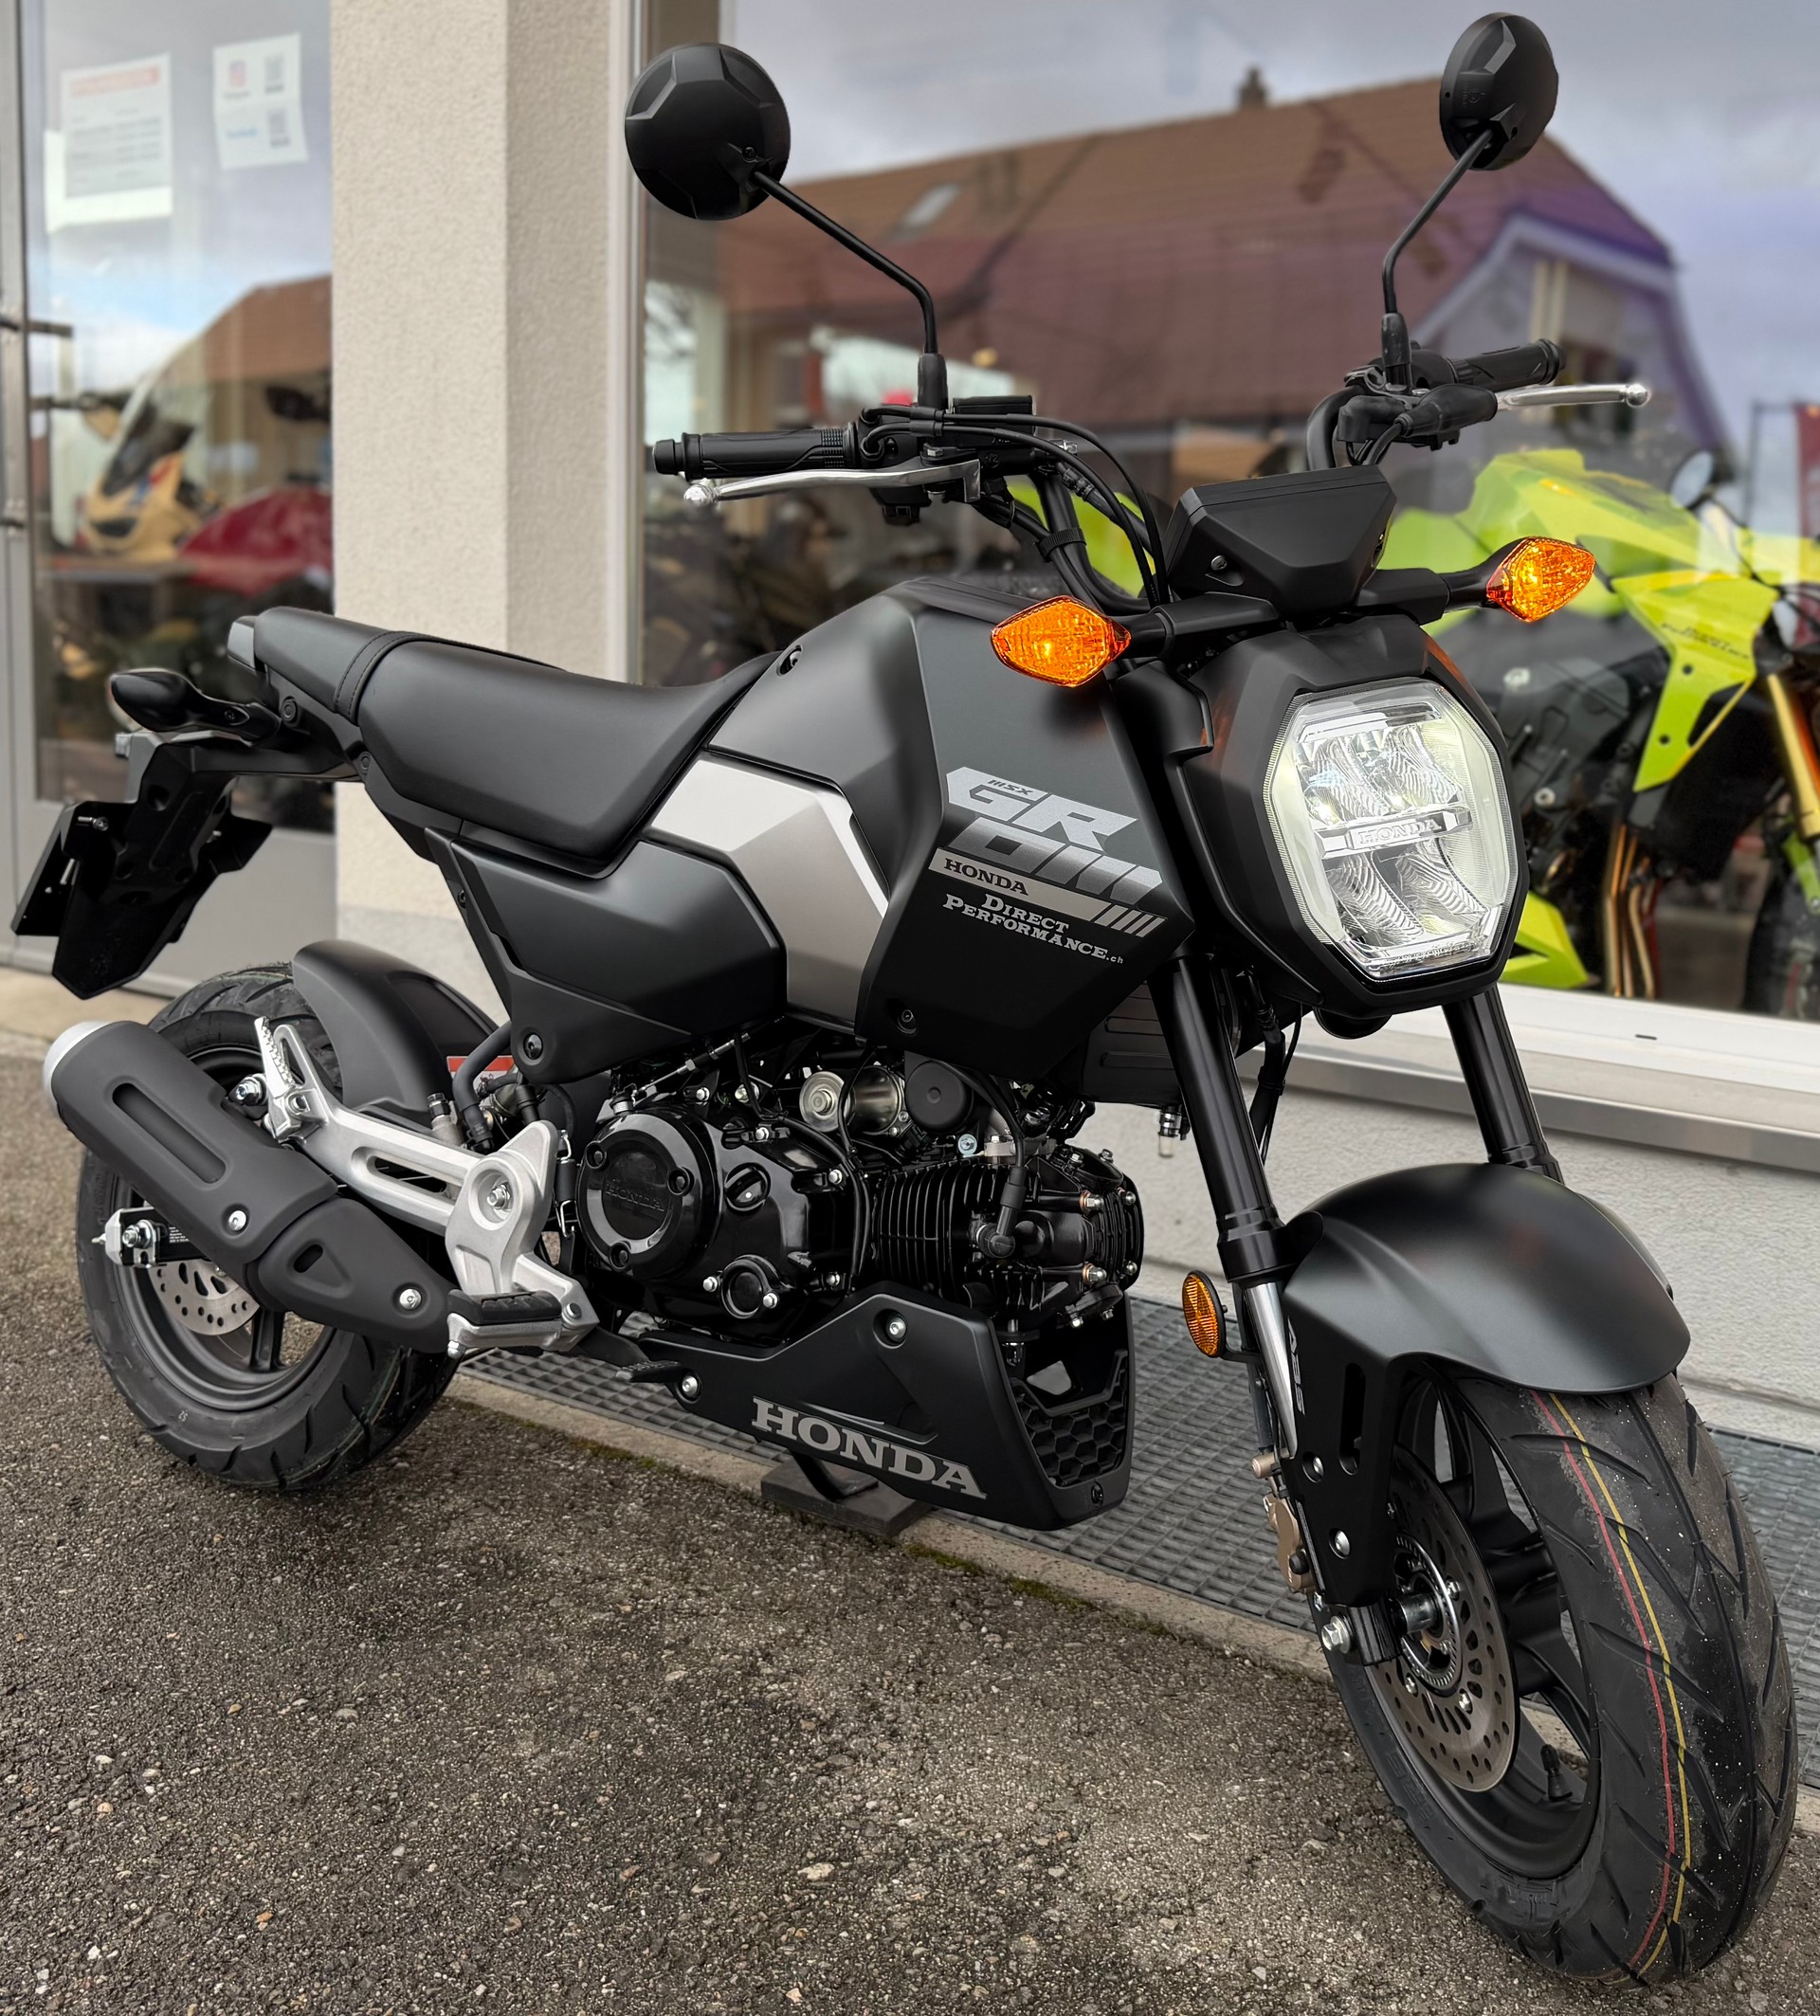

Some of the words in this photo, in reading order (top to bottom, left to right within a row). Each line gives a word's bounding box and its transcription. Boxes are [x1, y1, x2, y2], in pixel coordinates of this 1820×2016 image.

[987, 779, 1035, 796] MSX
[1358, 819, 1442, 844] HONDA
[943, 858, 1029, 897] HONDA
[942, 893, 1124, 964] PERFORMANCE.ch
[981, 893, 1069, 934] DIRECT
[1287, 1317, 1305, 1416] ABS
[752, 1396, 988, 1499] HONDA
